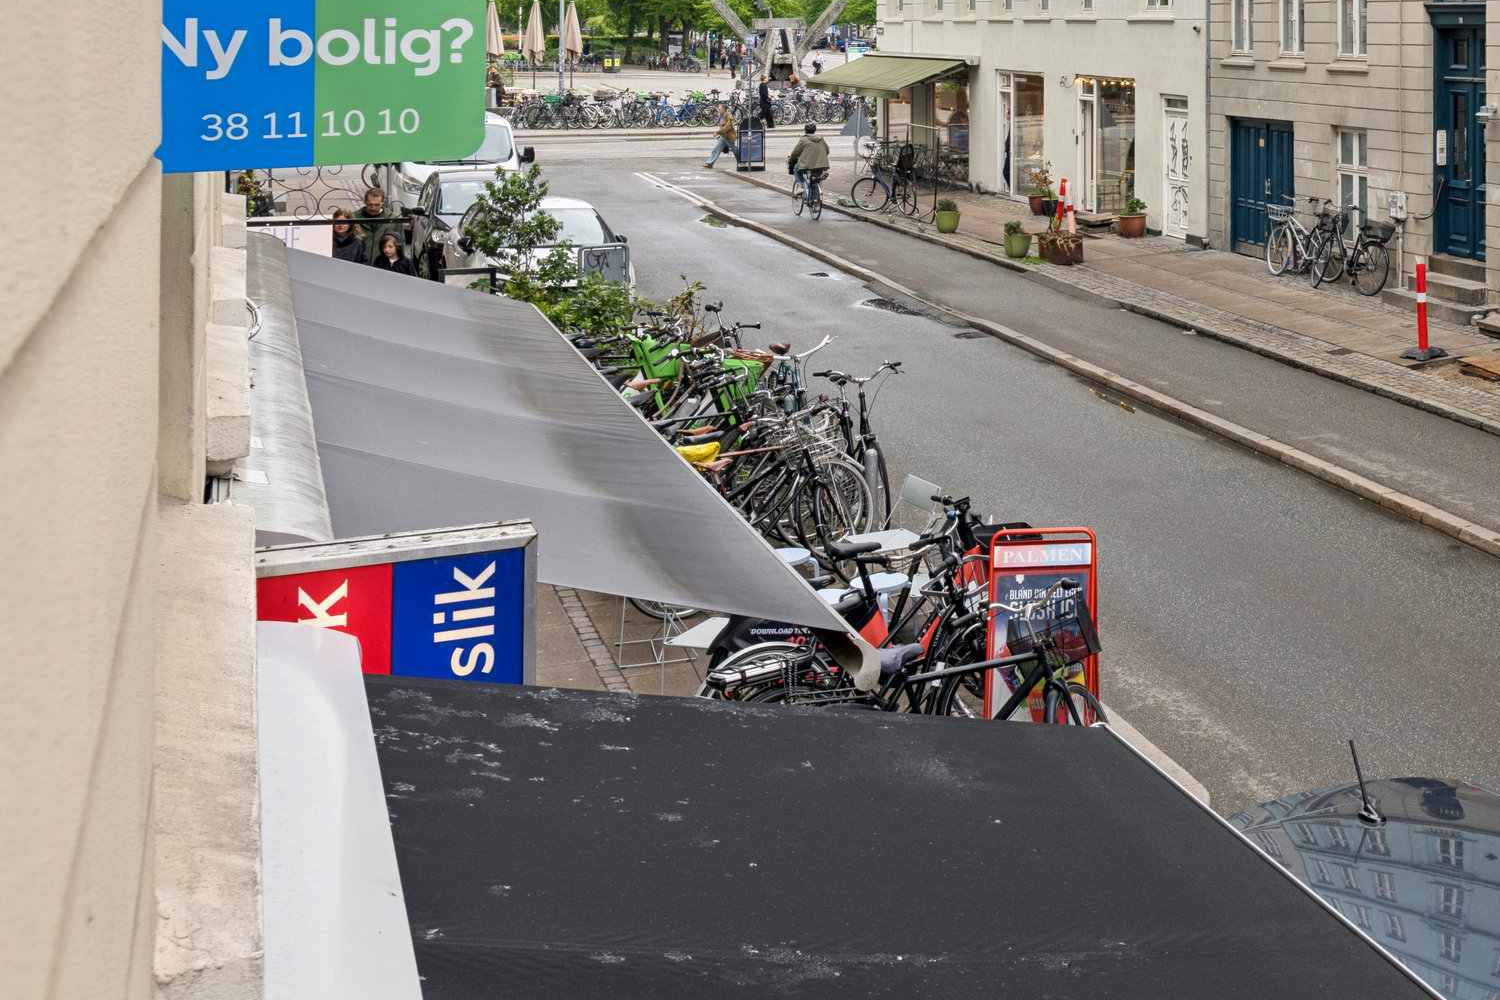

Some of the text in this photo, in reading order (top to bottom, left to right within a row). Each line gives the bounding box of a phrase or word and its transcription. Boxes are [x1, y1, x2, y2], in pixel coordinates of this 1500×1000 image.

[161, 18, 474, 80] Ny bolig?
[200, 108, 420, 142] 38 11 10 10
[1003, 548, 1083, 564] PALMEN
[433, 560, 496, 677] slik
